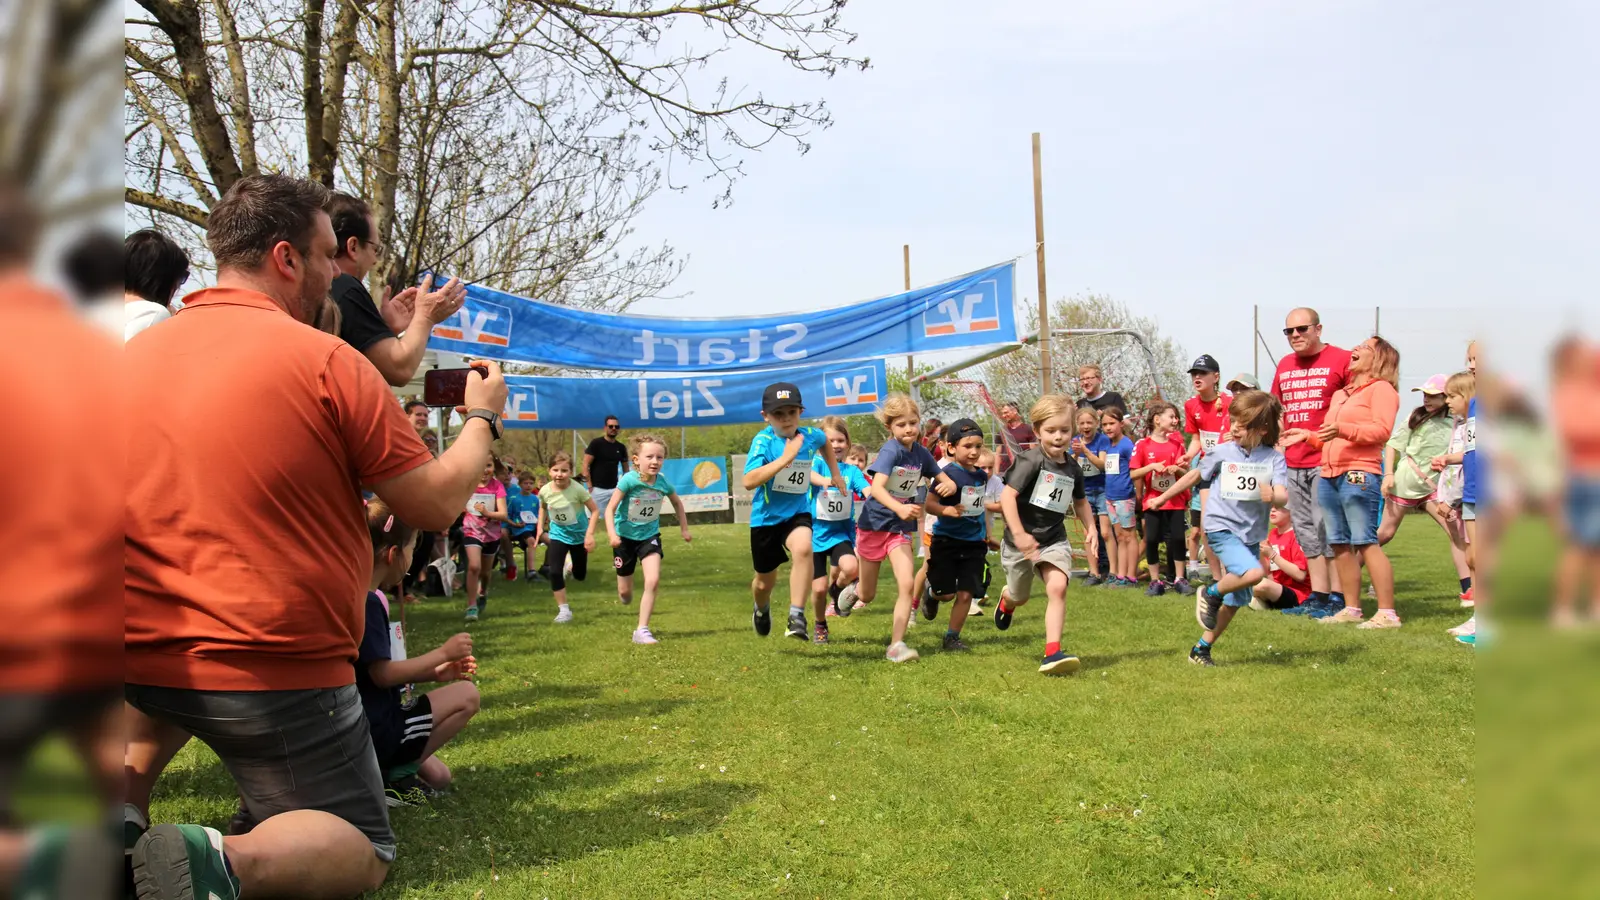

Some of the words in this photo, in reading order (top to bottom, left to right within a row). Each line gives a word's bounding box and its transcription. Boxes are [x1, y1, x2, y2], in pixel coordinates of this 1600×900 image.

[1290, 369, 1307, 378] SIND
[1307, 367, 1330, 376] DOCH
[1291, 379, 1308, 389] NUR
[776, 390, 790, 399] CAT
[1293, 390, 1308, 399] UNS
[1308, 389, 1323, 398] DIE
[1300, 400, 1324, 410] NICHT
[1205, 439, 1216, 449] 95
[788, 471, 805, 485] 48
[1237, 476, 1257, 490] 39
[900, 480, 914, 491] 47
[1158, 480, 1170, 488] 69
[1048, 488, 1063, 502] 41
[640, 506, 654, 517] 42
[828, 501, 843, 513] 50
[555, 513, 567, 522] 43
